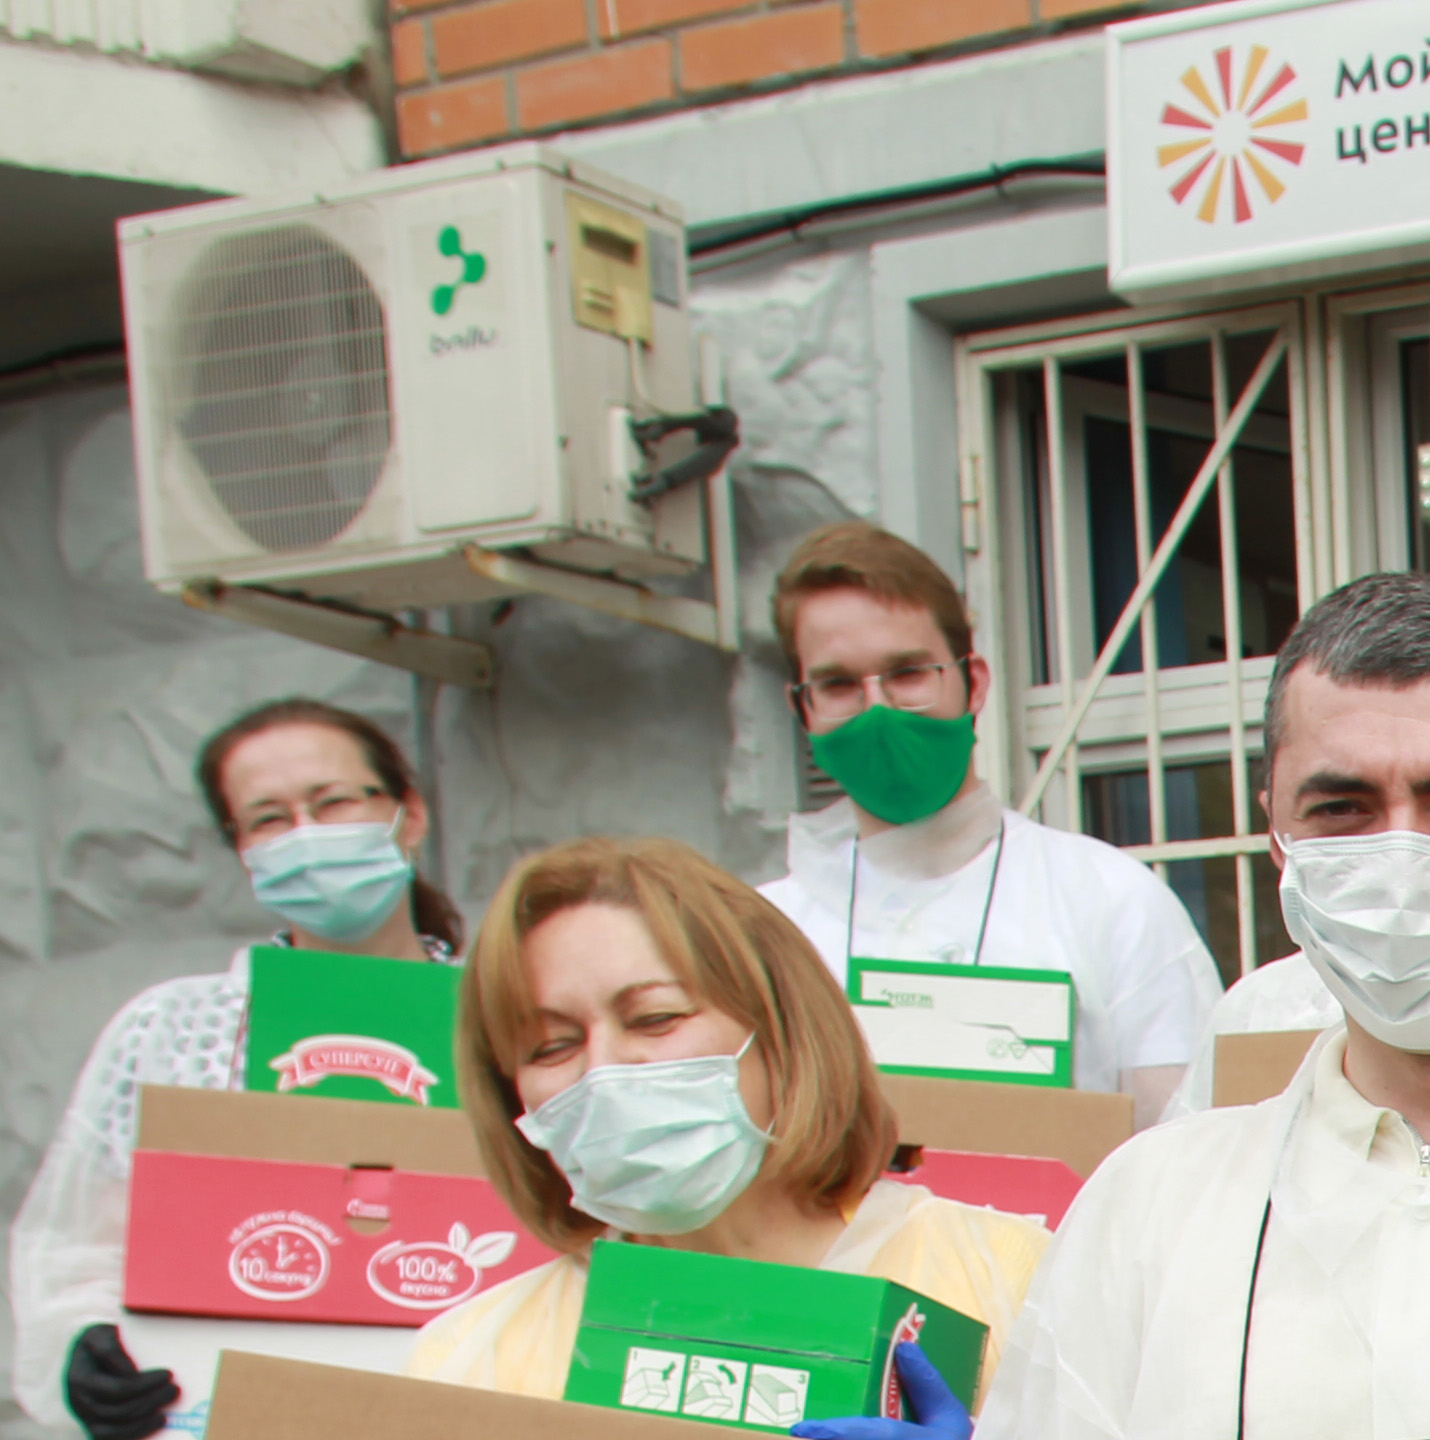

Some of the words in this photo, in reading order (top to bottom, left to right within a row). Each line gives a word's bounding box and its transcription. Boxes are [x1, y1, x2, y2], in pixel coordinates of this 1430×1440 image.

[309, 1051, 400, 1075] СУПЕРСУП
[240, 1257, 265, 1281] 10
[395, 1255, 458, 1283] 100%
